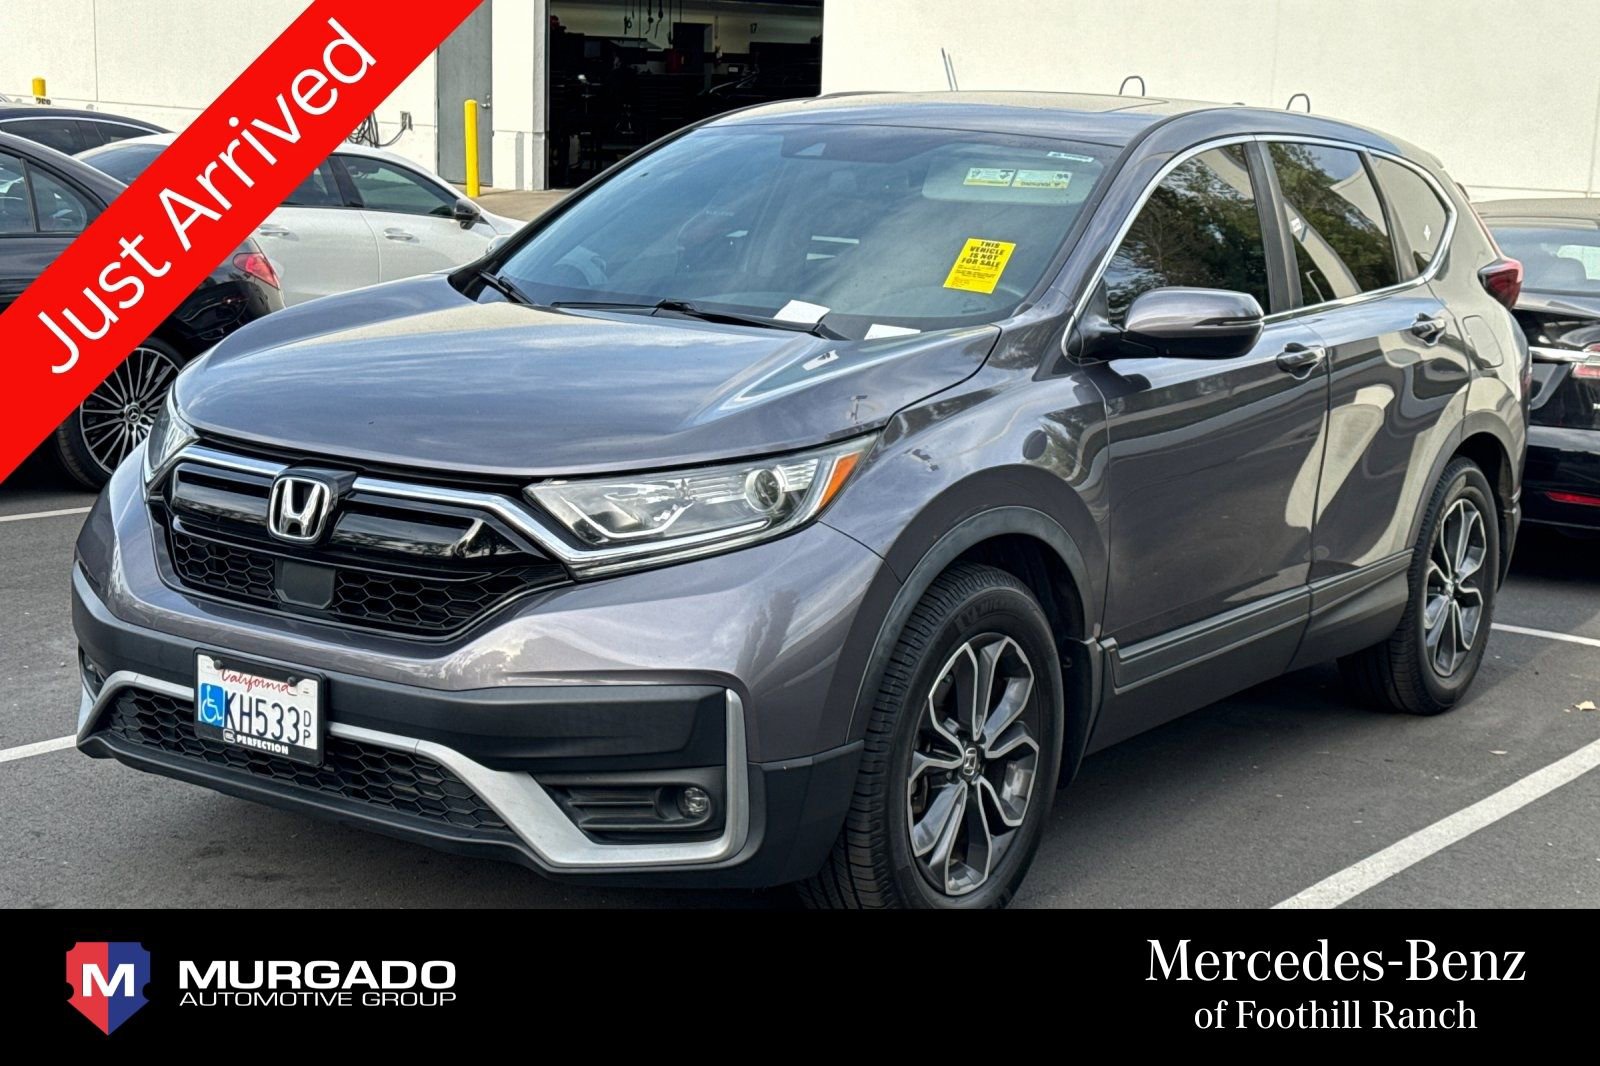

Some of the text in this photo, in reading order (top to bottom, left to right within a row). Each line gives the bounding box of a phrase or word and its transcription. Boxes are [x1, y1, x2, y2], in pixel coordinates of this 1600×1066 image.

[970, 246, 1005, 255] VEHICLE
[221, 668, 298, 697] California
[224, 690, 300, 744] KH533
[236, 734, 289, 755] PERFECTION
